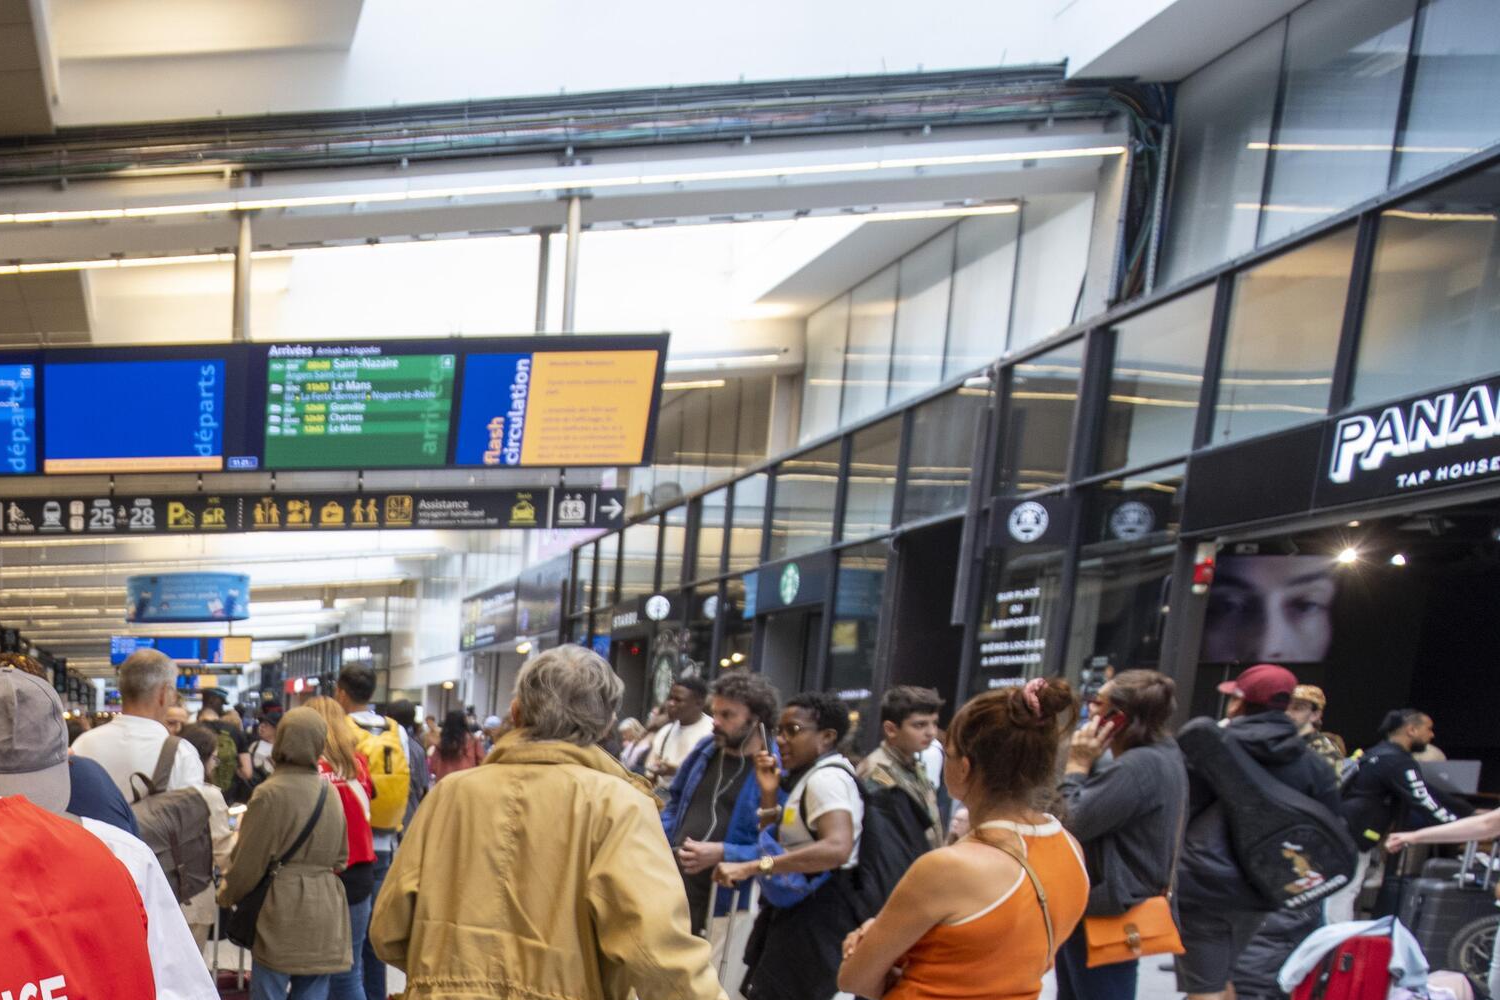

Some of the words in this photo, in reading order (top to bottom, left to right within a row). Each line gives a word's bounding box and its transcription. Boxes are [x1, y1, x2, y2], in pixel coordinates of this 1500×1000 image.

[268, 345, 314, 357] Arrivées
[333, 357, 398, 369] Saint-Nazaire
[331, 382, 344, 391] Le
[345, 381, 372, 391] Mans
[194, 364, 219, 457] départs
[330, 413, 363, 422] Chartres
[504, 358, 531, 465] circulation
[8, 381, 31, 471] départs
[1328, 384, 1500, 484] PANA
[483, 417, 505, 465] flash
[1396, 469, 1431, 488] TAP
[1436, 455, 1500, 481] HOUSE
[168, 501, 186, 525] P
[418, 499, 469, 510] Assistance
[91, 508, 115, 526] 25
[130, 507, 155, 526] 28
